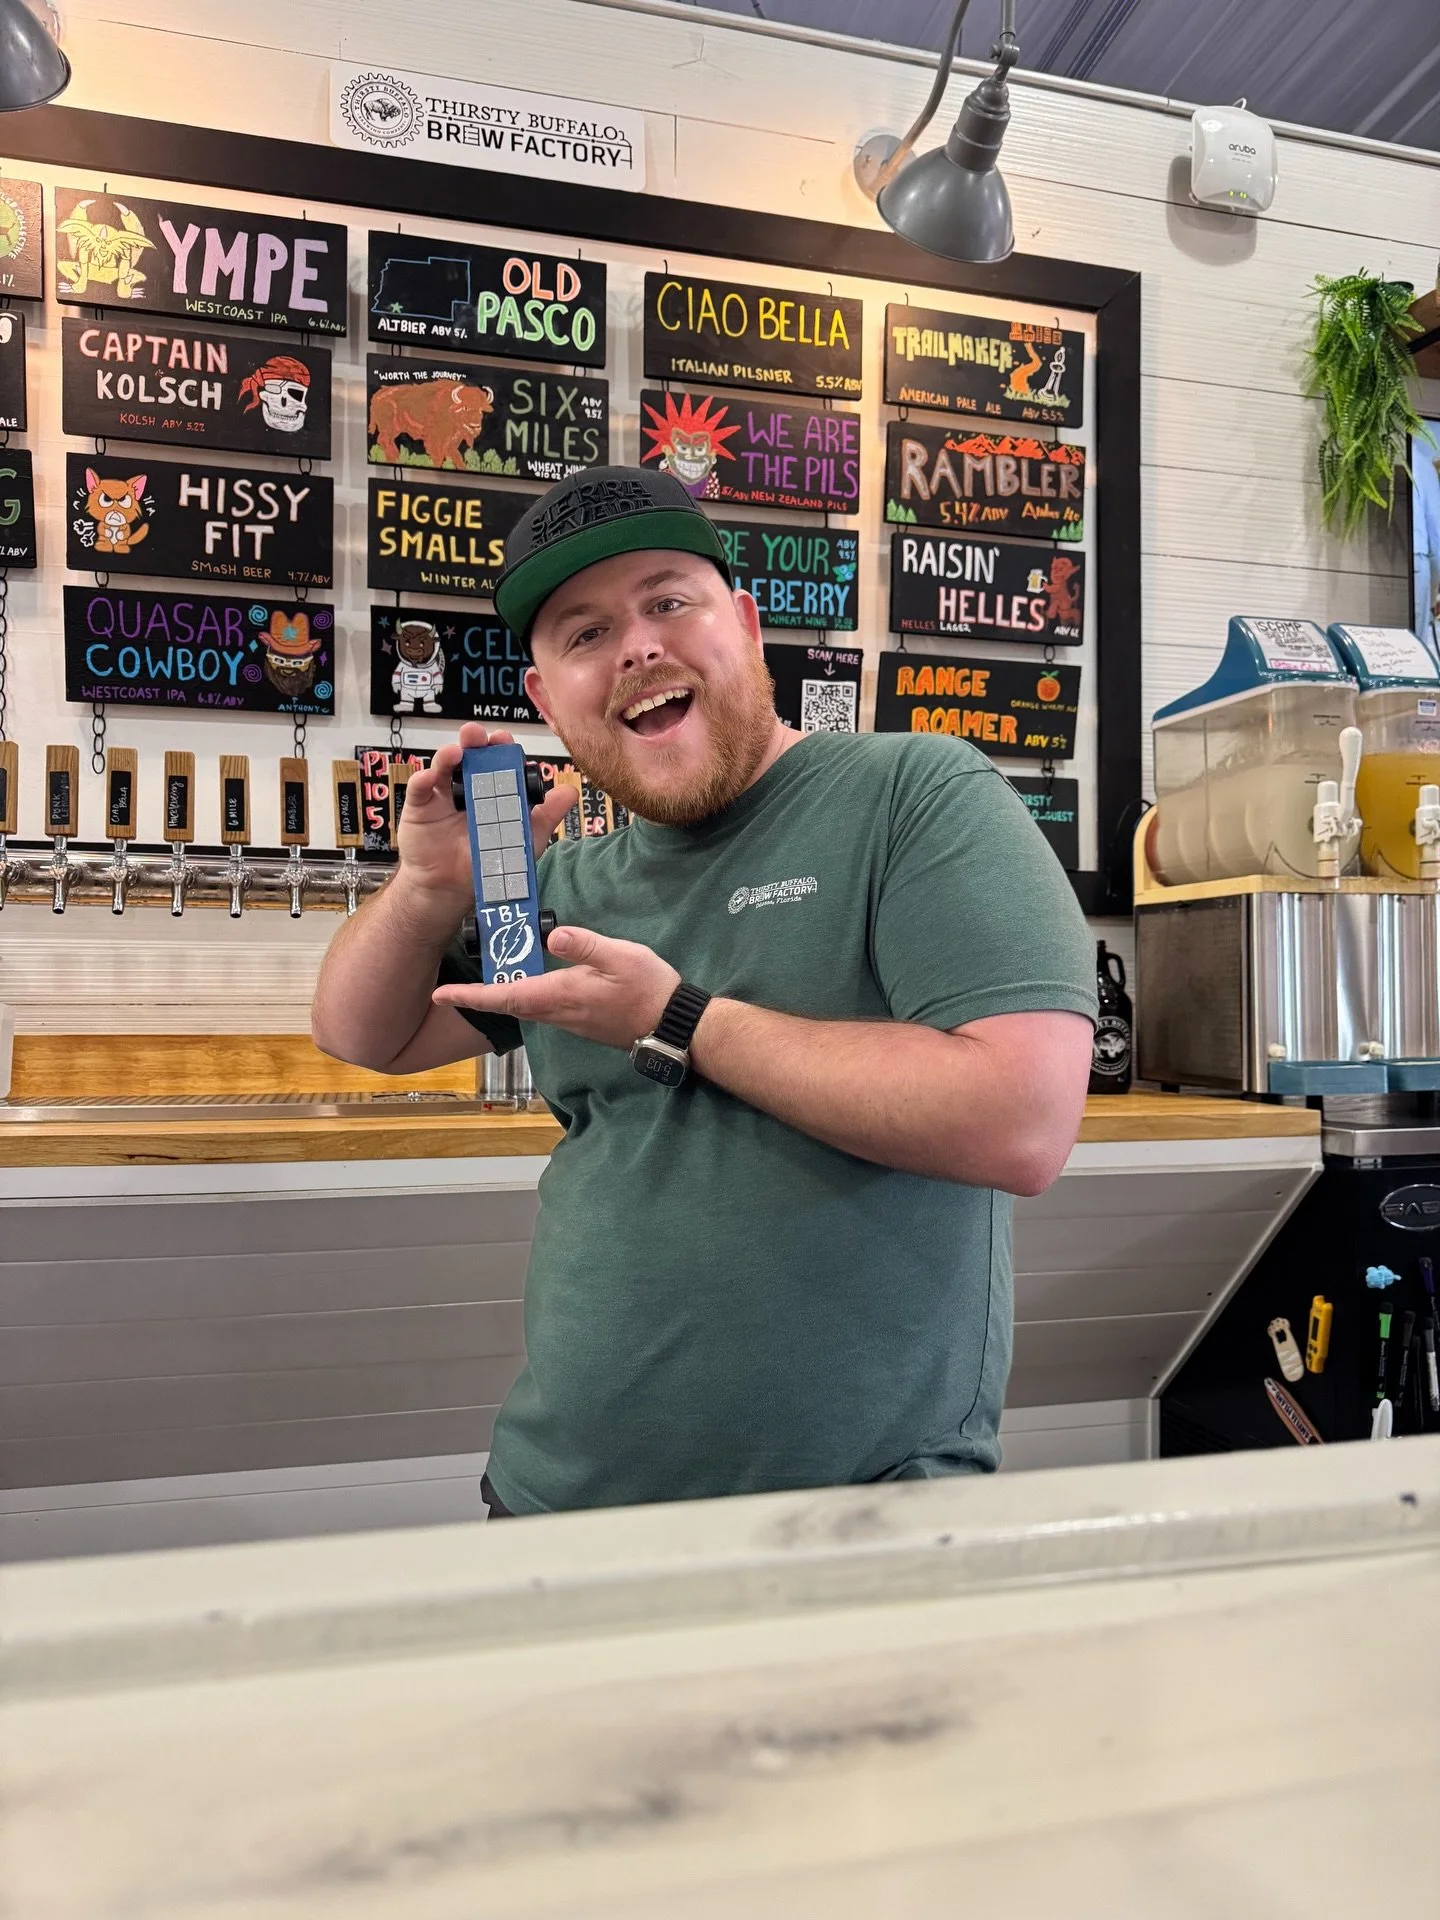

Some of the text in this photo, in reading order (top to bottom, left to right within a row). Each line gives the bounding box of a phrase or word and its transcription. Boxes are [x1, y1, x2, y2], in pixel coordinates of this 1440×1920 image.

[425, 97, 618, 141] THIRSTY BUFFALO
[427, 120, 622, 167] BREW FACTORY
[1228, 143, 1256, 155] aruba
[8, 209, 27, 260] COLLECTIVE
[159, 215, 329, 313] YMPE
[502, 257, 581, 302] OLD
[185, 299, 288, 325] WESTCOAST IPA
[477, 291, 596, 352] PASCO
[657, 281, 850, 350] CIAO BELLA
[377, 317, 427, 335] ALTBIER
[431, 325, 452, 337] ABV
[79, 329, 228, 375] CAPTAIN
[893, 326, 1013, 373] TRAILMAKER
[412, 371, 429, 380] THE
[671, 358, 793, 384] ITALIAN PILSNER
[815, 375, 862, 391] 5.5% ABV
[96, 370, 222, 411] KOLSCH
[509, 379, 578, 421] SIX
[581, 396, 603, 408] ABV
[899, 387, 1002, 415] AMERICAN PALE ALE
[120, 413, 156, 426] KOLSH
[162, 418, 184, 430] ABV
[747, 411, 859, 455] WE ARE
[505, 420, 599, 463] MILES
[527, 460, 563, 473] WHEAT
[741, 452, 858, 499] THE PILS
[901, 438, 1081, 500] RAMBLER
[178, 473, 310, 522] HISSY
[376, 490, 483, 529] FIGGIE
[530, 480, 652, 532] SIERRA
[751, 490, 775, 502] NEW
[778, 494, 823, 509] ZEALAND
[827, 501, 847, 511] PILS
[7, 547, 28, 556] ABV
[204, 520, 275, 560] FIT
[379, 527, 505, 567] SMALLS
[719, 529, 830, 576] BE YOUR
[837, 539, 857, 550] ABV
[243, 566, 272, 580] BEER
[902, 538, 1000, 584] RAISIN'
[311, 573, 331, 584] ABV
[421, 571, 501, 590] WINTER AL
[86, 596, 244, 647] QUASAR
[768, 613, 801, 625] WHEAT
[938, 586, 1045, 631] HELLES
[901, 619, 972, 633] HELLES LAGER
[1258, 621, 1302, 632] SCAMP
[85, 643, 244, 686] COWBOY
[807, 648, 859, 665] SCAN HERE
[81, 685, 186, 701] WESTCOAST IPA
[896, 666, 990, 697] RANGE
[223, 695, 244, 707] ABV
[278, 703, 320, 713] ANTHONY
[473, 704, 509, 718] HAZY
[514, 705, 530, 719] IPA
[912, 706, 1018, 744] ROAMER
[1024, 734, 1049, 748] ABV
[364, 782, 389, 801] 10
[52, 794, 61, 820] PUNK
[111, 804, 120, 822] CIAO
[228, 797, 238, 818] MILE
[773, 886, 813, 898] FACTORY
[781, 877, 813, 887] BUFFALO
[480, 903, 529, 927] TBL
